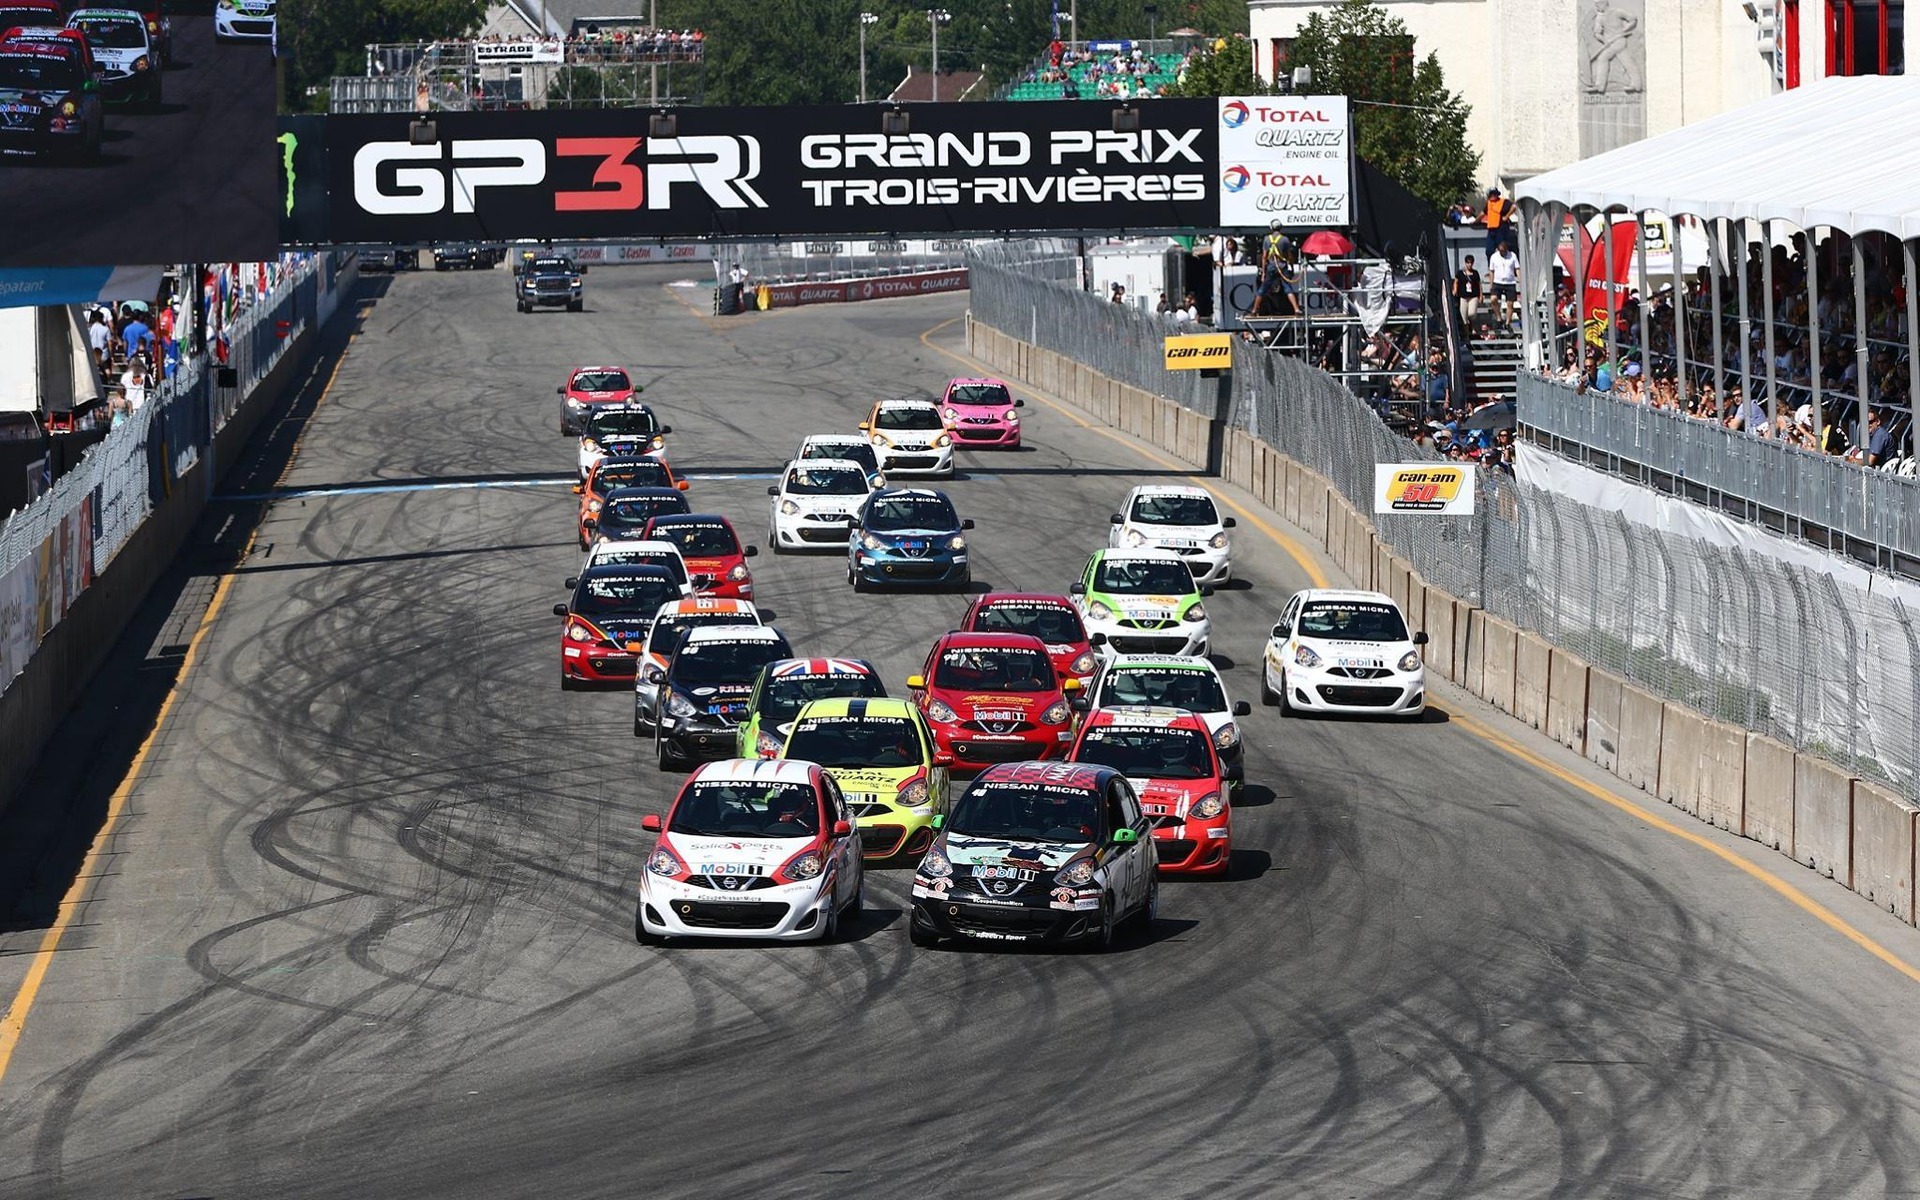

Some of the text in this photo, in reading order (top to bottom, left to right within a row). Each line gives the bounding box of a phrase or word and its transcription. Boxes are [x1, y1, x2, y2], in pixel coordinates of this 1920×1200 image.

[1255, 108, 1330, 122] TOTAL
[1255, 128, 1344, 147] QUARTZ
[1050, 129, 1204, 165] PRIX
[353, 135, 769, 215] GP3R
[1256, 172, 1331, 186] TOTAL
[1256, 193, 1345, 212] QUARTZ
[1287, 215, 1340, 223] ENGINE OIL
[672, 246, 696, 257] Castrol
[876, 277, 961, 292] TOTAL QUARTZ
[773, 289, 840, 300] OTAL QUARTZ
[1167, 346, 1229, 358] can-am
[1398, 474, 1456, 482] can-am
[1403, 483, 1440, 502] 50
[895, 541, 923, 549] Mobil
[1129, 610, 1159, 618] Mobil
[1359, 606, 1390, 614] MICRA
[608, 630, 639, 640] Mobil
[1002, 647, 1037, 655] MICRA
[1338, 658, 1371, 667] Mobil
[776, 674, 826, 682] NISSAN
[1170, 669, 1206, 677] MICRA
[1106, 674, 1118, 686] 11
[807, 716, 905, 725] NISSAN MICRA
[974, 712, 1011, 720] Mobil
[1102, 716, 1191, 727] KENWOOD
[1086, 733, 1105, 741] 28
[1153, 727, 1193, 738] MICRA
[693, 781, 799, 791] NISSAN MICRA
[984, 783, 1089, 796] NISSAN MICRA
[695, 789, 701, 797] 1
[844, 793, 861, 802] bil
[700, 864, 745, 875] Mobil
[971, 866, 1017, 879] Mobil
